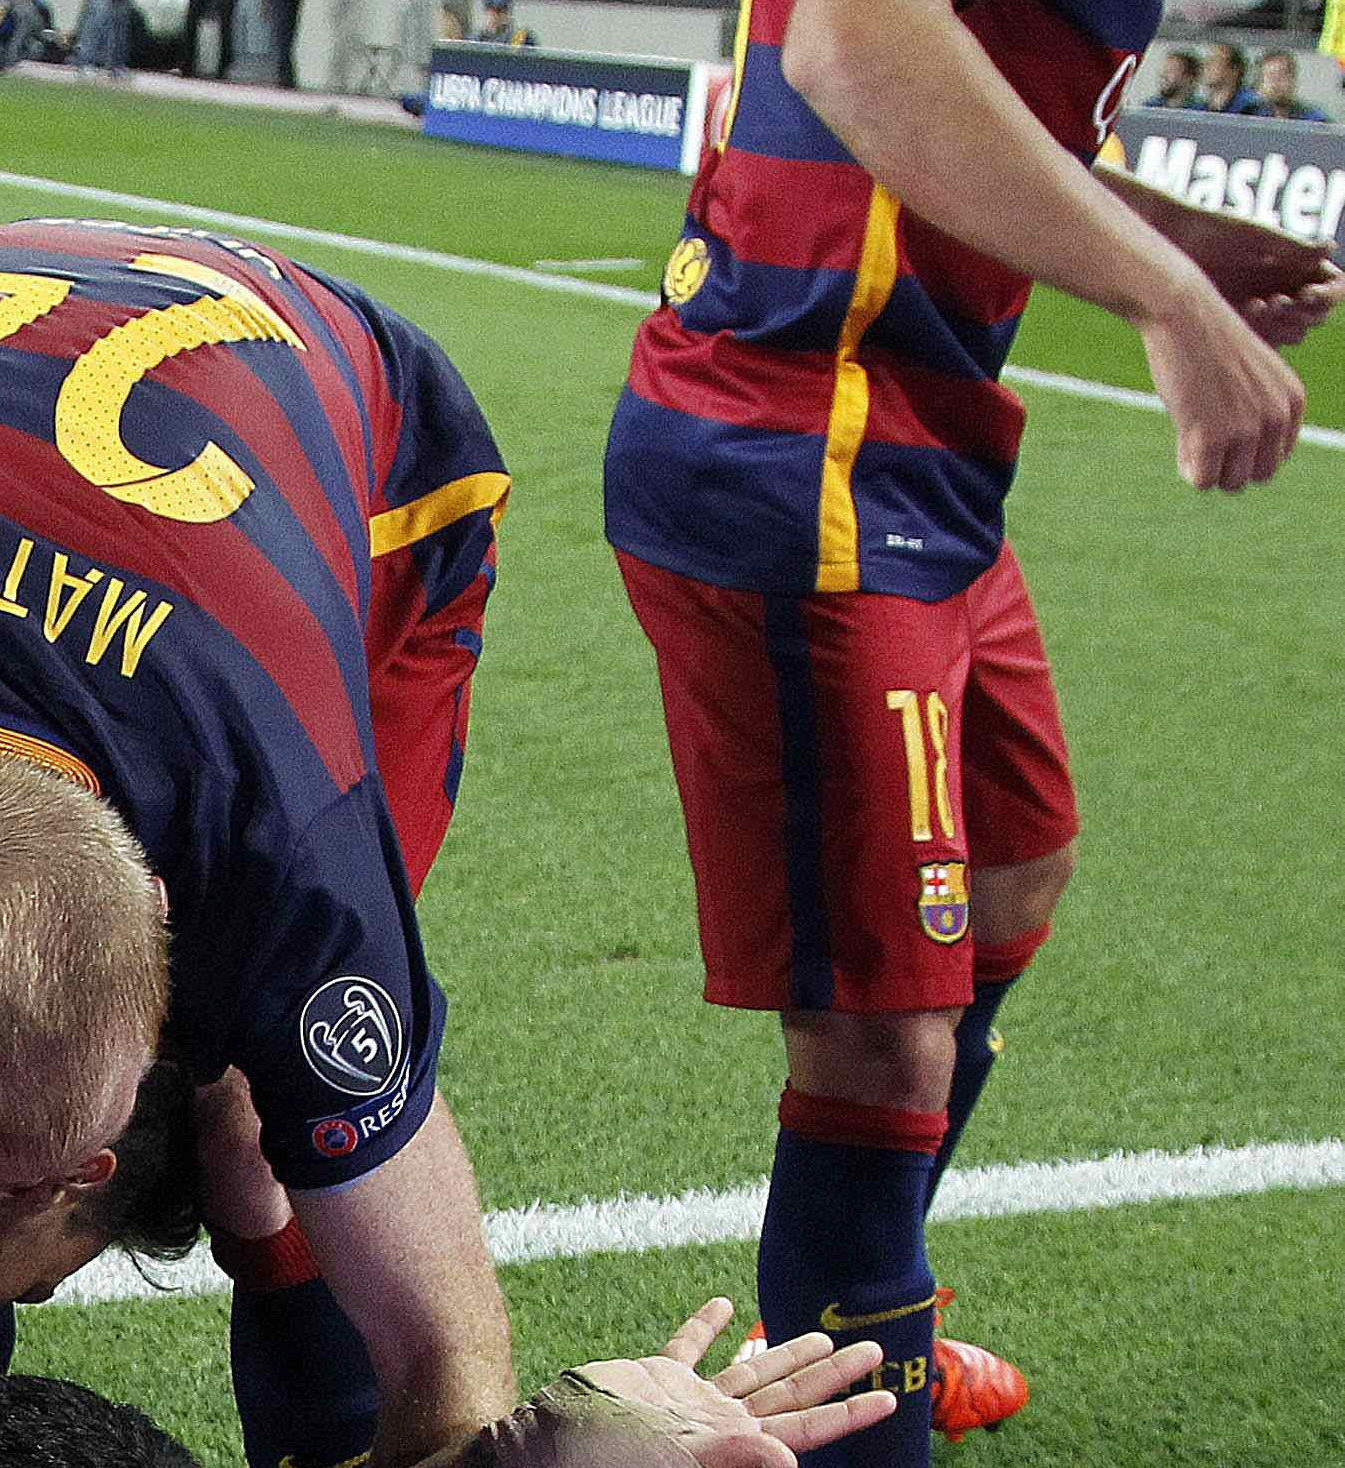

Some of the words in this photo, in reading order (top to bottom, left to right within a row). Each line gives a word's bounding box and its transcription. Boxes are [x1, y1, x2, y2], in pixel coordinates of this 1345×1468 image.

[482, 77, 598, 126] CHAMPIONS
[598, 89, 684, 137] LEAGUE
[351, 1028, 378, 1064] 5
[359, 1059, 411, 1138] RESP
